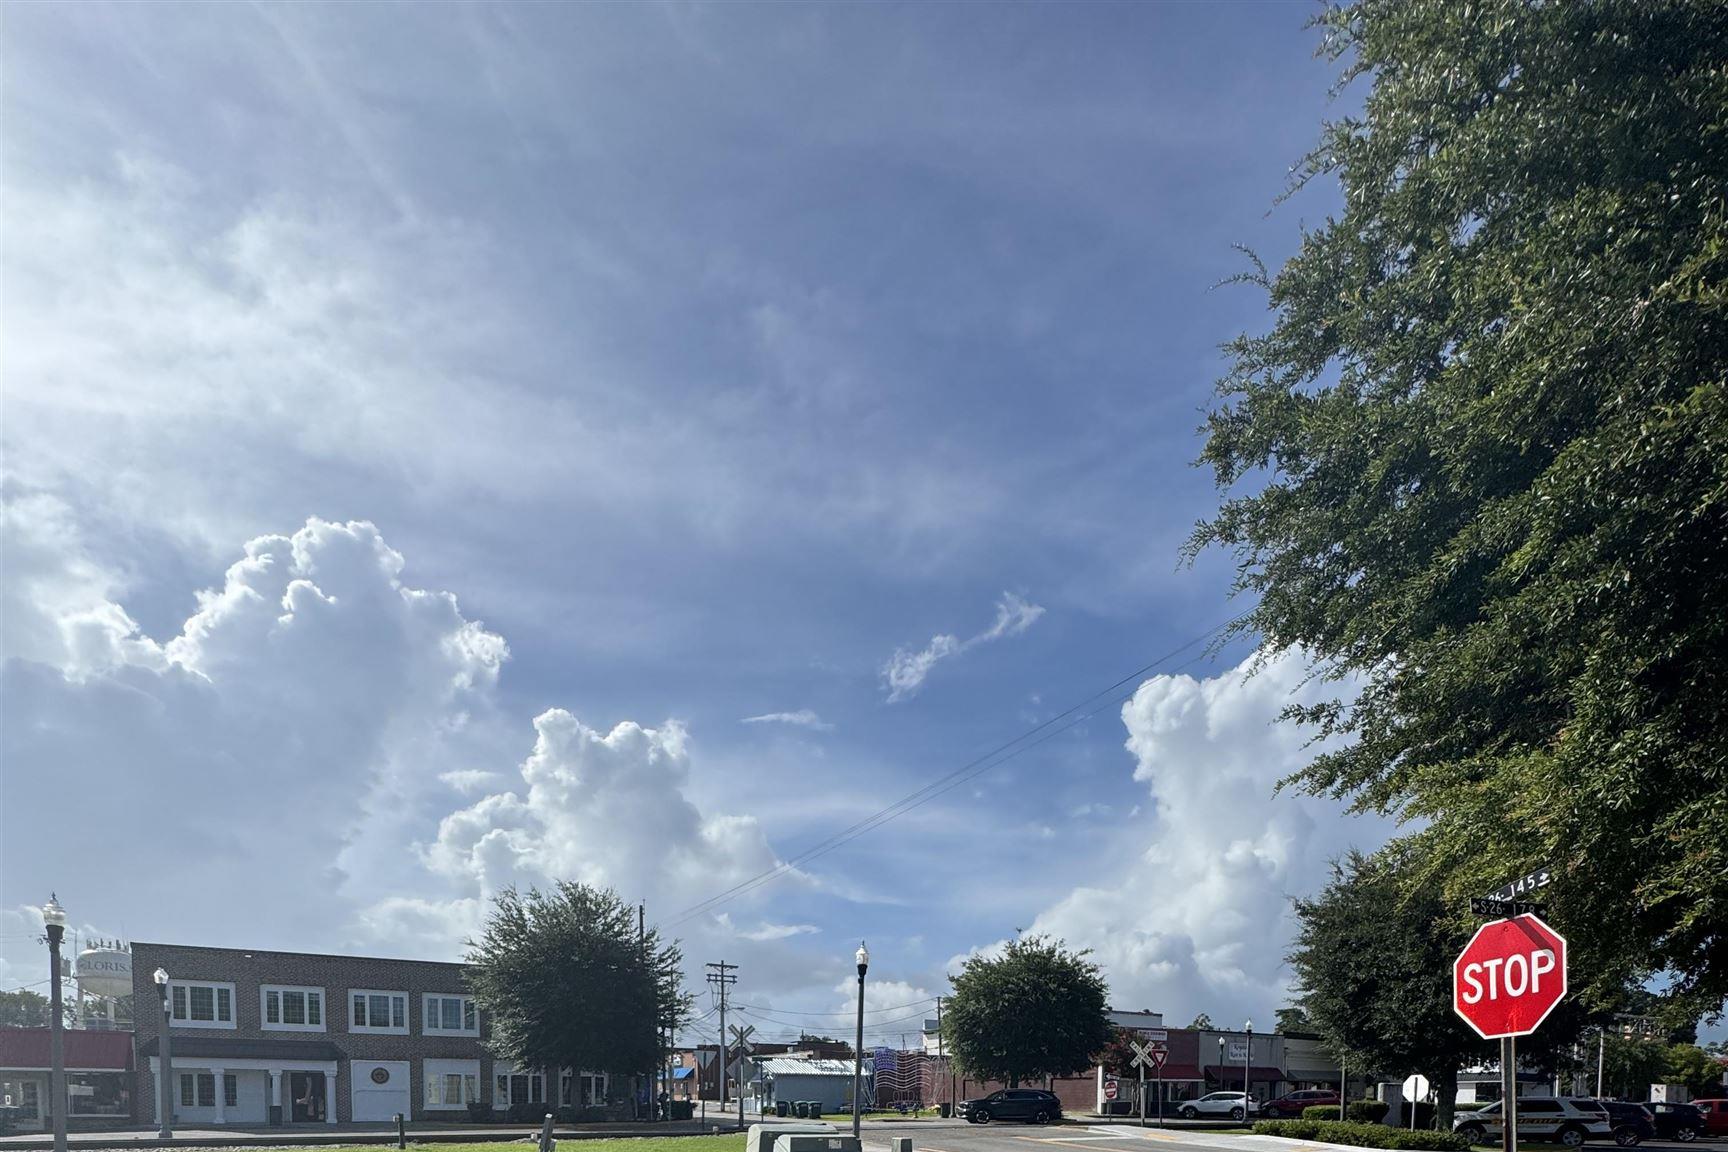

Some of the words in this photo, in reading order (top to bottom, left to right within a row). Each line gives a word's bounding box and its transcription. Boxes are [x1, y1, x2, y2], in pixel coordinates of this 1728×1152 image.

[1510, 874, 1536, 897] 145
[87, 960, 129, 972] LORIS
[1462, 948, 1555, 1004] STOP
